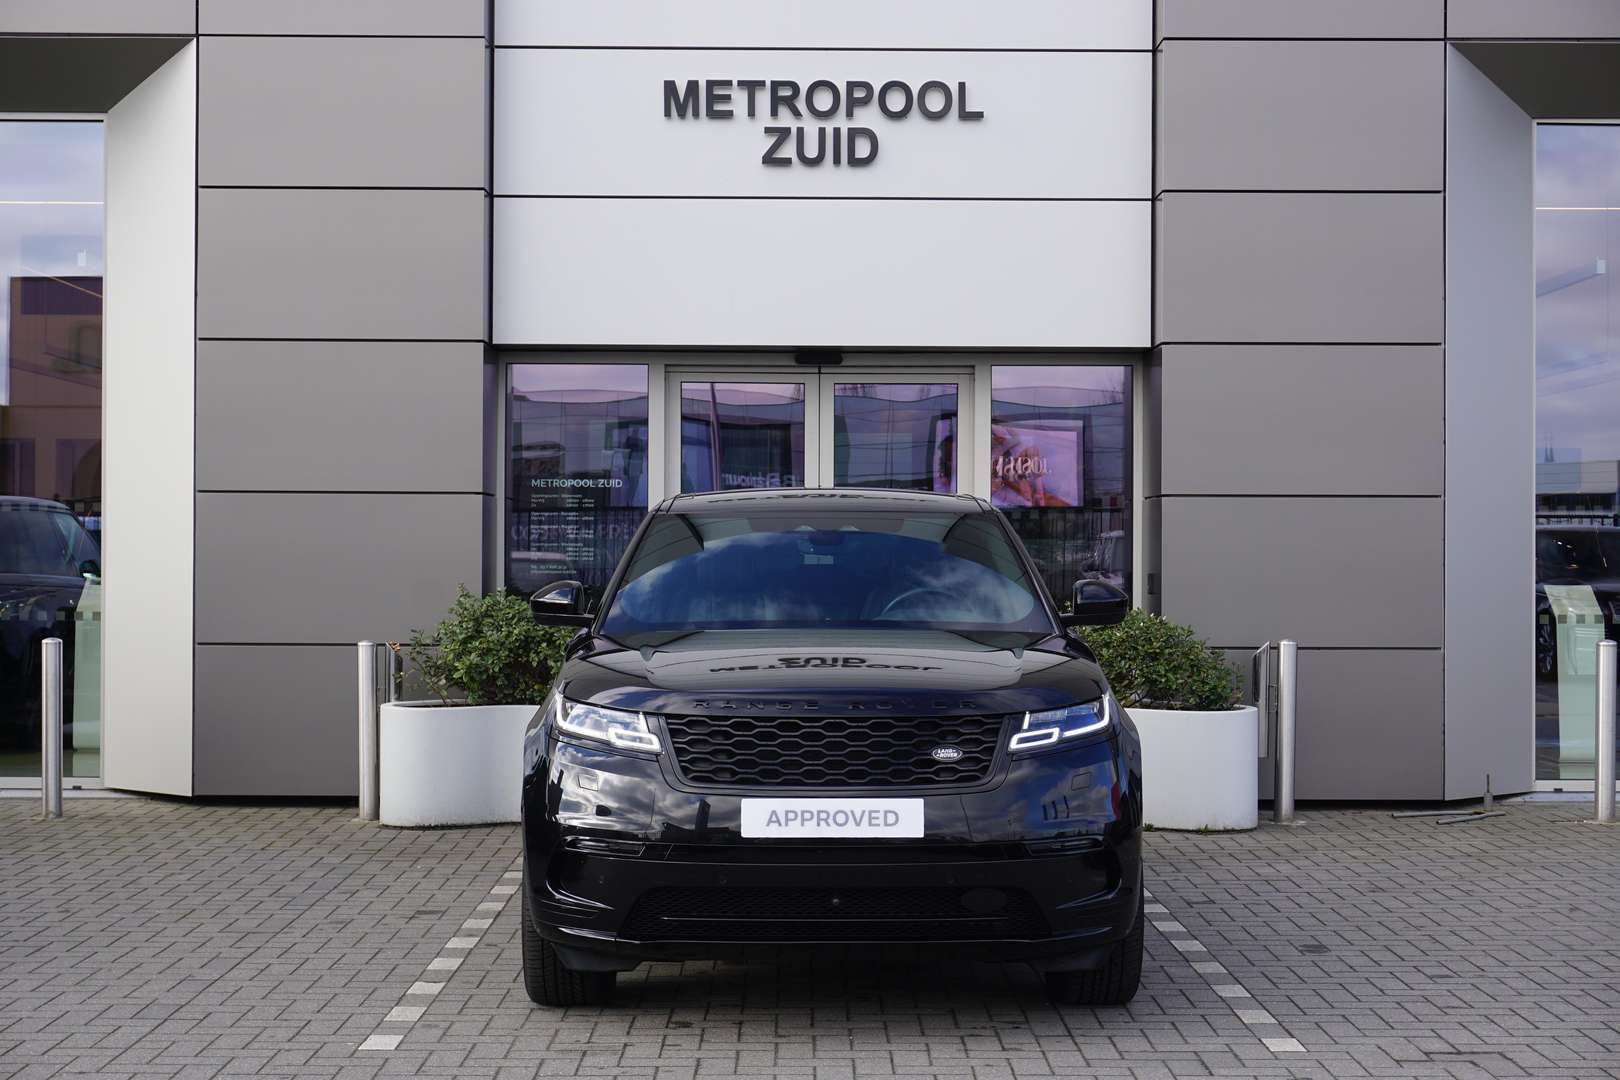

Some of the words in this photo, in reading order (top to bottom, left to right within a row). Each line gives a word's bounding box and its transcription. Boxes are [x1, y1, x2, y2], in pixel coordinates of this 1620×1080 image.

[663, 79, 985, 120] METROPOOL
[762, 126, 880, 168] ZUID
[531, 479, 596, 488] METROPOOL
[598, 479, 623, 488] ZUID
[693, 700, 820, 711] RANGE
[766, 810, 900, 827] APPROVED
